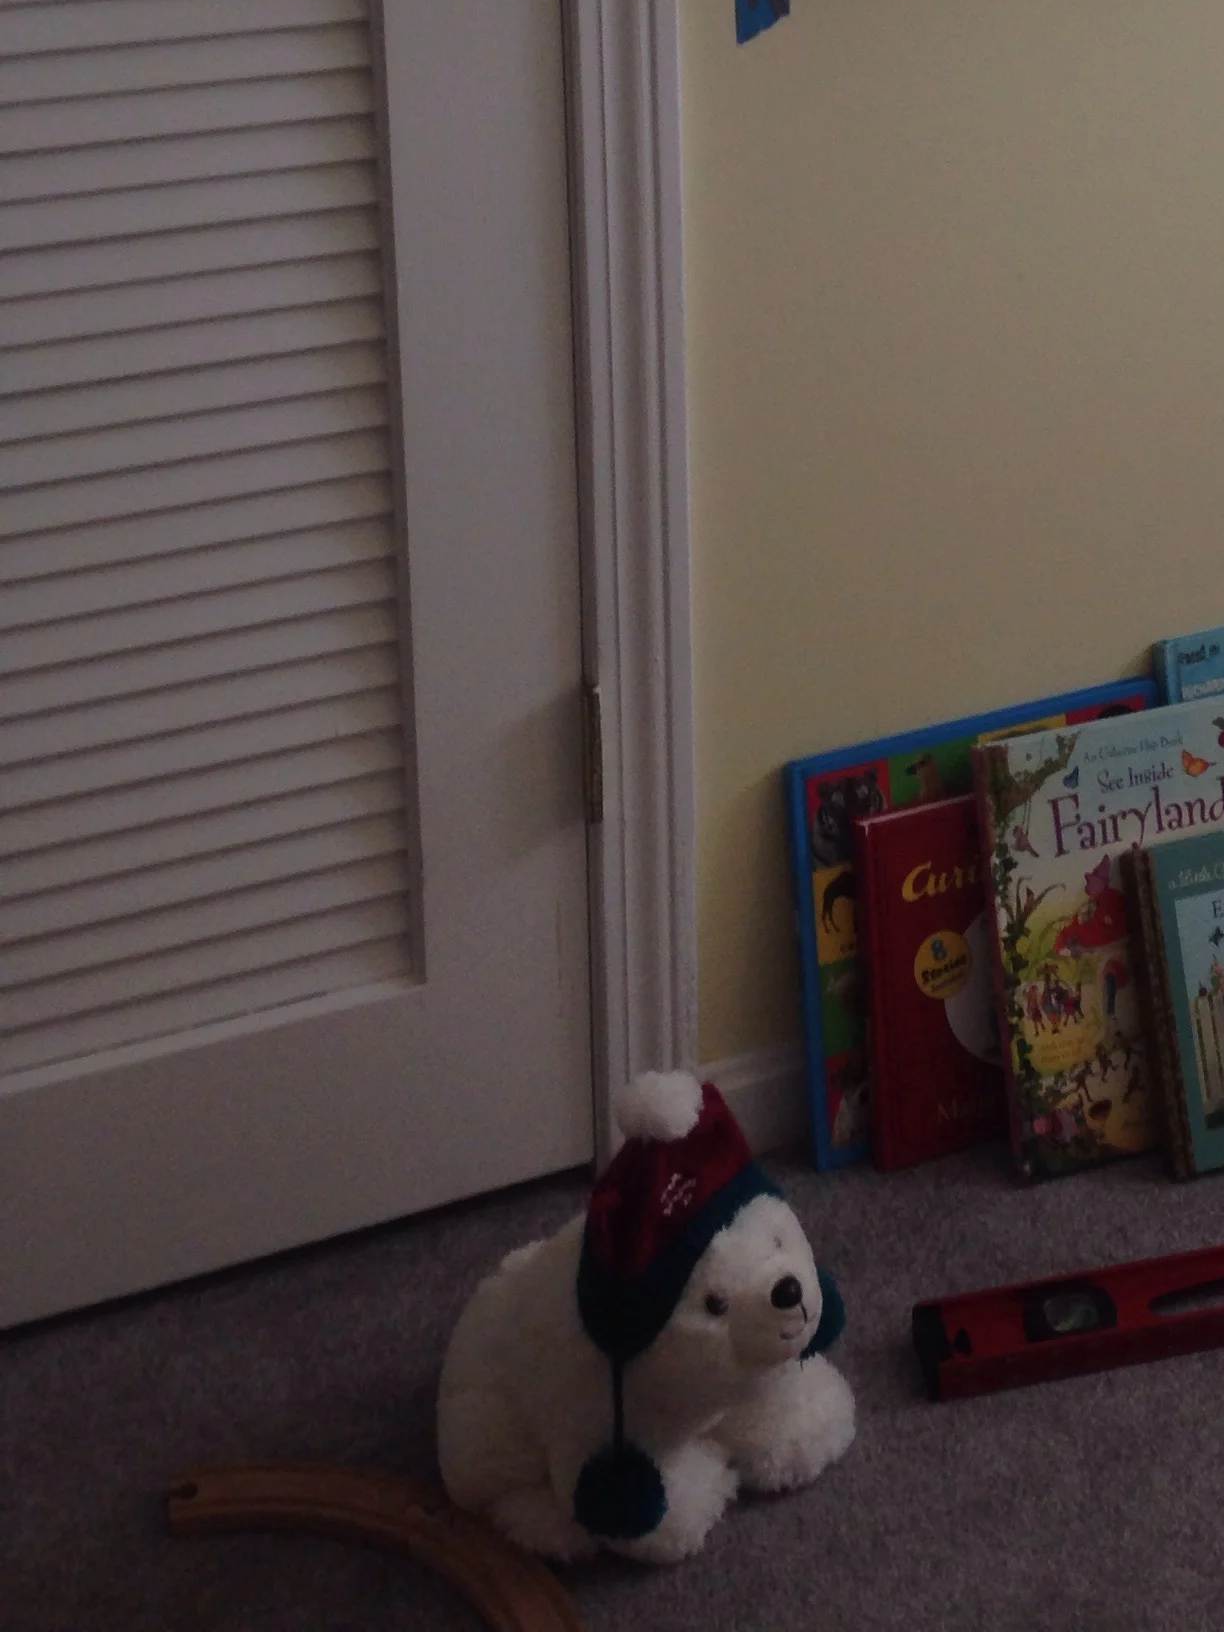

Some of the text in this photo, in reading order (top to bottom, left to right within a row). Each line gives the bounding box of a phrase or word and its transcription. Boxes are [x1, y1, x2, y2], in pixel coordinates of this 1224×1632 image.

[1097, 760, 1174, 794] See Inside
[931, 939, 948, 960] 8
